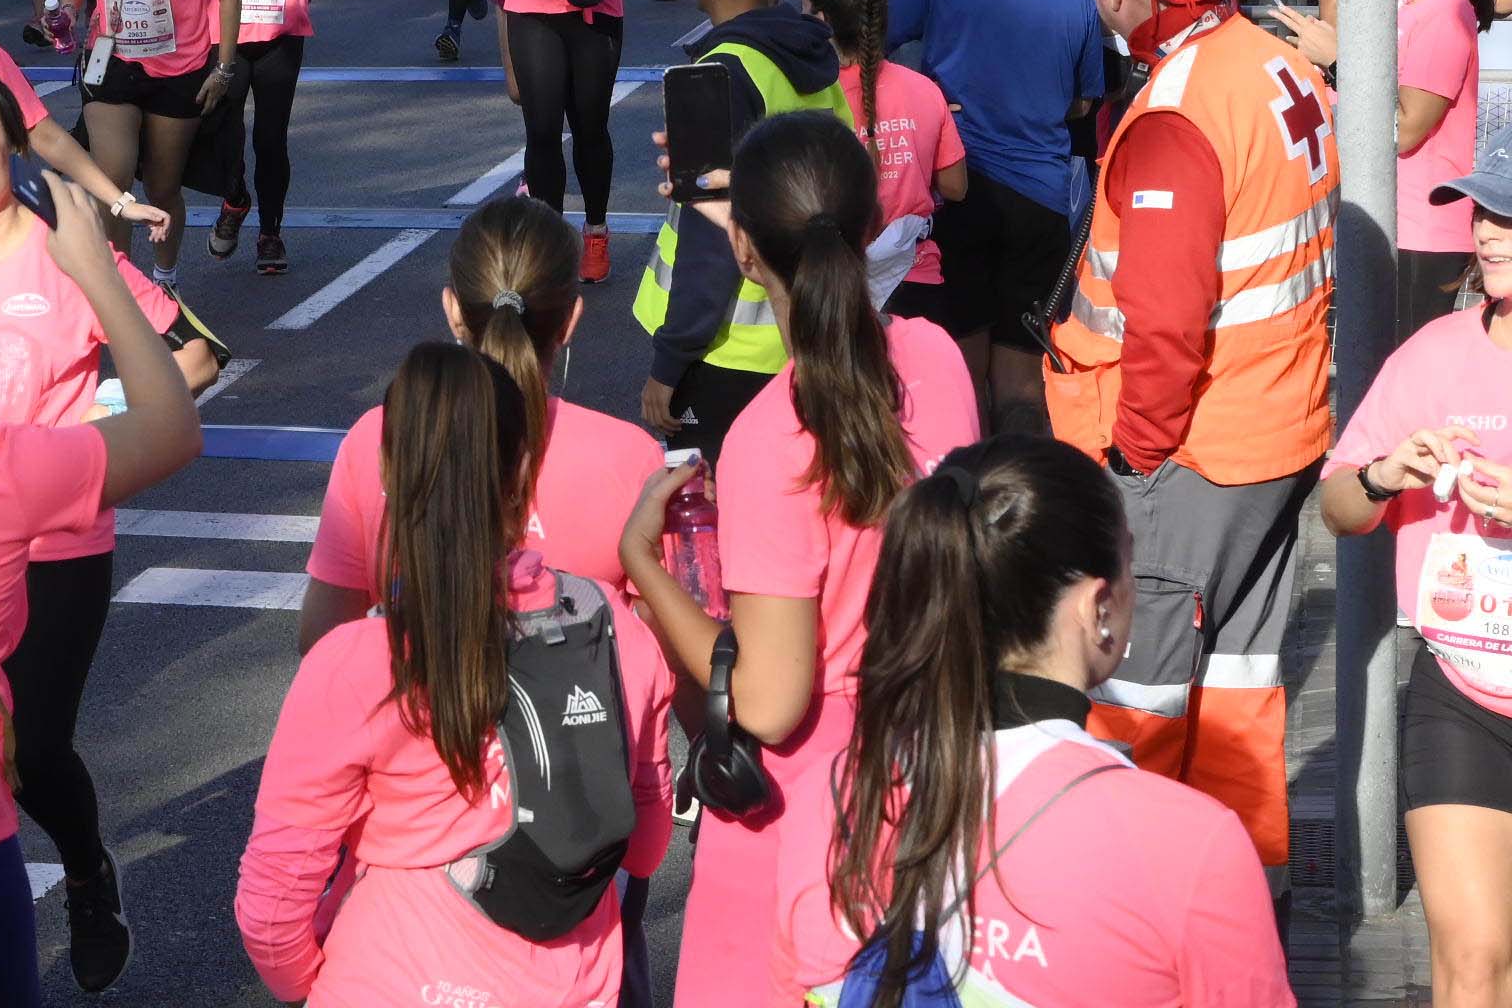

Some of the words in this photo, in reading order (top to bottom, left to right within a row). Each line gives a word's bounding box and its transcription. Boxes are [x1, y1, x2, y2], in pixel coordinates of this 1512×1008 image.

[124, 20, 148, 30] 016
[890, 135, 908, 148] LA
[1436, 633, 1483, 649] CARRERA
[1485, 641, 1499, 650] DE
[561, 711, 607, 727] AONIJIE
